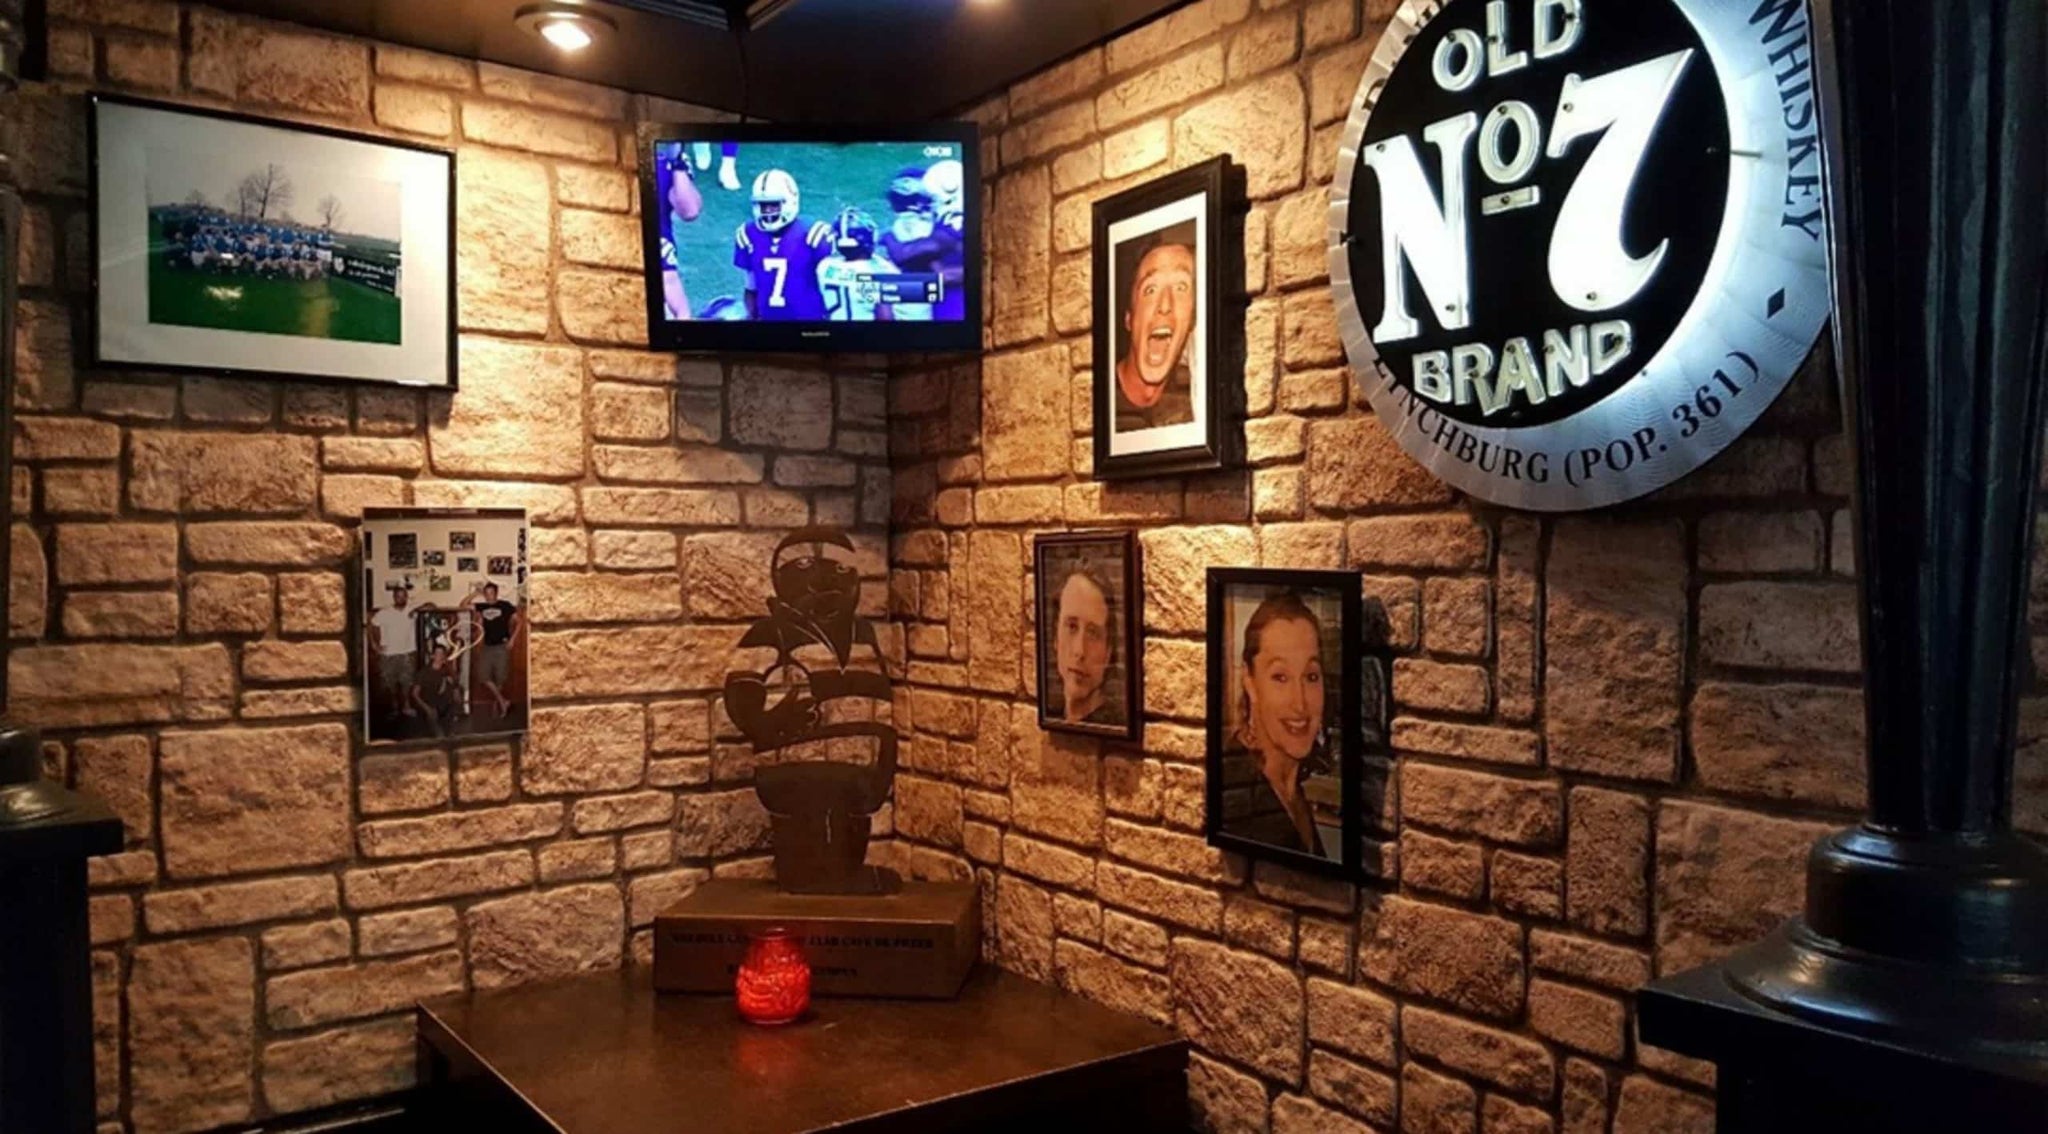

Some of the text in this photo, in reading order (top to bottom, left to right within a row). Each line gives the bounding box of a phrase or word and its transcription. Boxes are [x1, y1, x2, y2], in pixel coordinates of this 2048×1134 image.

[1432, 0, 1582, 92] OLD
[1748, 0, 1823, 242] WHISKEY
[762, 257, 789, 308] 7
[1412, 319, 1632, 416] BRAND
[1563, 427, 1668, 487] (POP.
[1671, 350, 1760, 439] 361)
